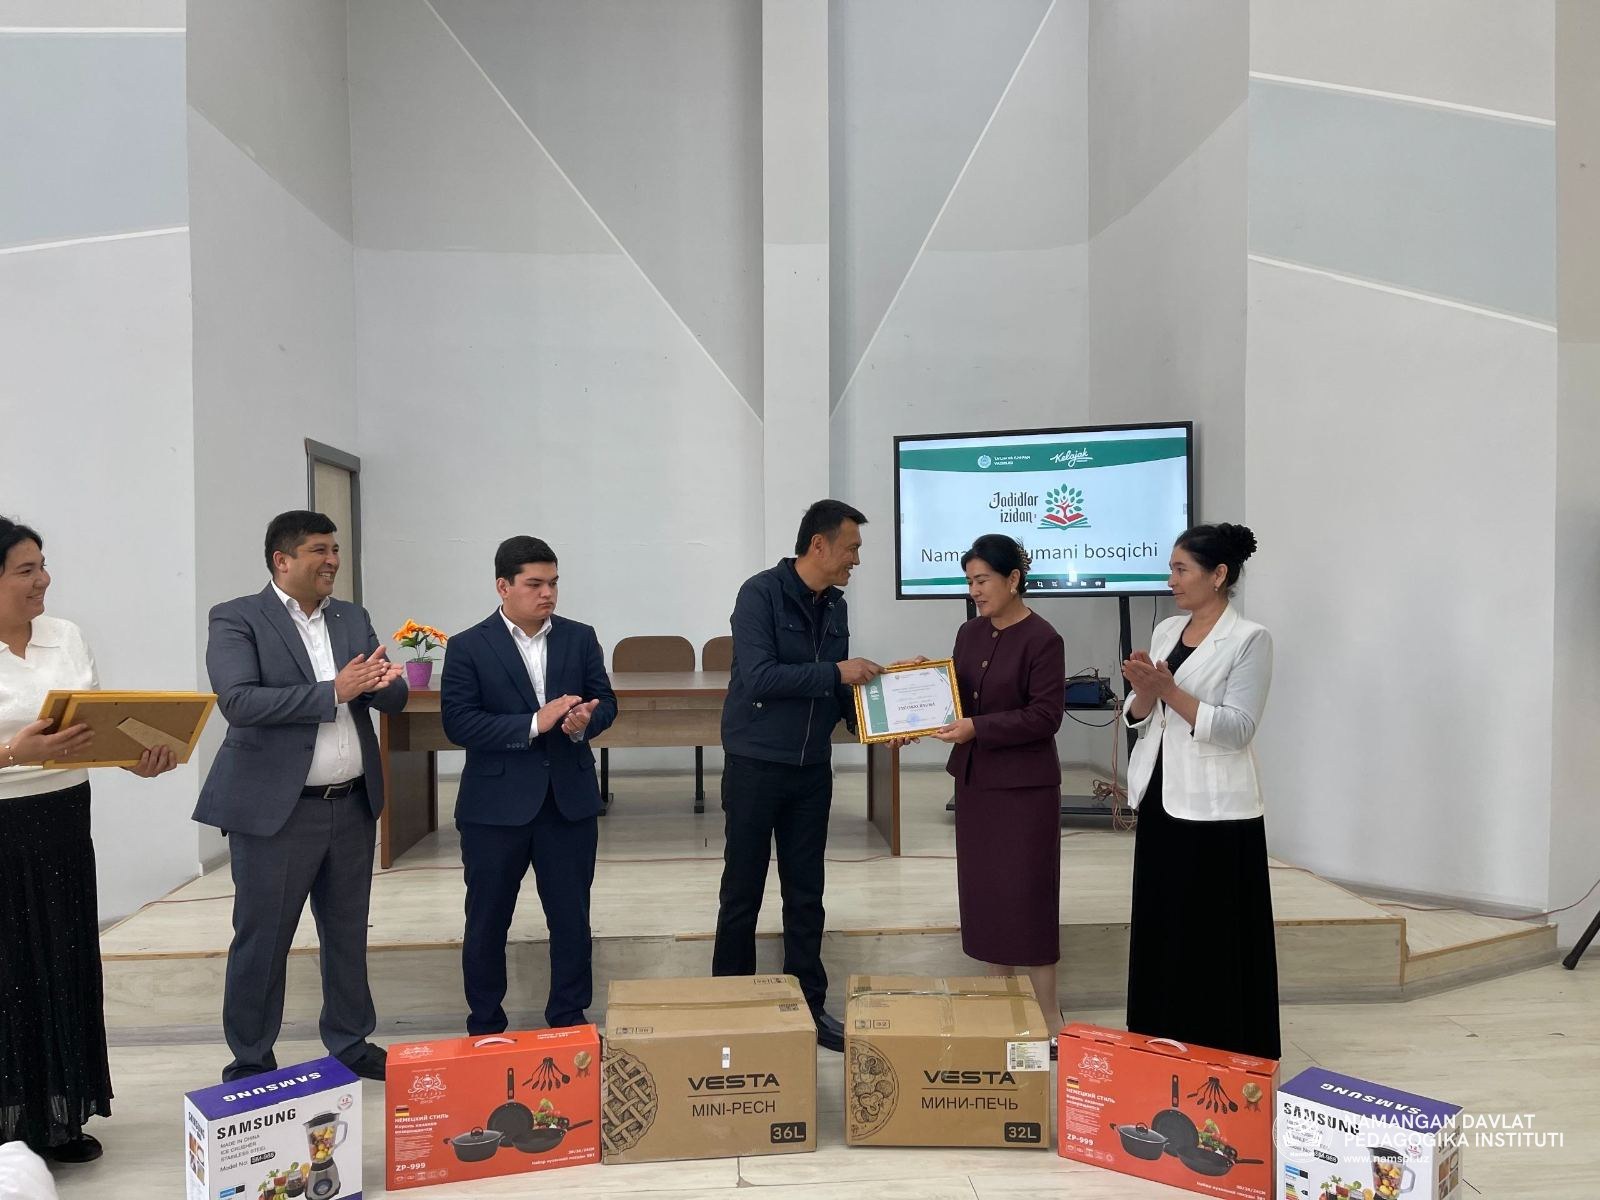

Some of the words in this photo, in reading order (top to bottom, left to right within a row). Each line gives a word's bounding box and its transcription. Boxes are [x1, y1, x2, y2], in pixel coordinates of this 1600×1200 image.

[1050, 448, 1092, 467] Kelajak
[989, 492, 1038, 508] Jadidlar
[1000, 508, 1032, 523] izidan
[1085, 542, 1158, 562] bosqichi
[688, 1073, 780, 1090] VESTA
[924, 1070, 1016, 1085] VESTA
[222, 1072, 321, 1102] SAMSUNG
[921, 1097, 1018, 1110] МИНИ-ПЕЧЬ
[1320, 1083, 1422, 1114] SAMSUNG
[692, 1100, 776, 1117] MINI-PECH
[217, 1108, 296, 1140] SAMSUNG
[1284, 1103, 1360, 1135] SAMSUNG
[773, 1126, 804, 1140] 36L
[1008, 1126, 1037, 1138] 32L
[1066, 1133, 1094, 1146] ZP-999
[395, 1162, 426, 1172] ZP-999
